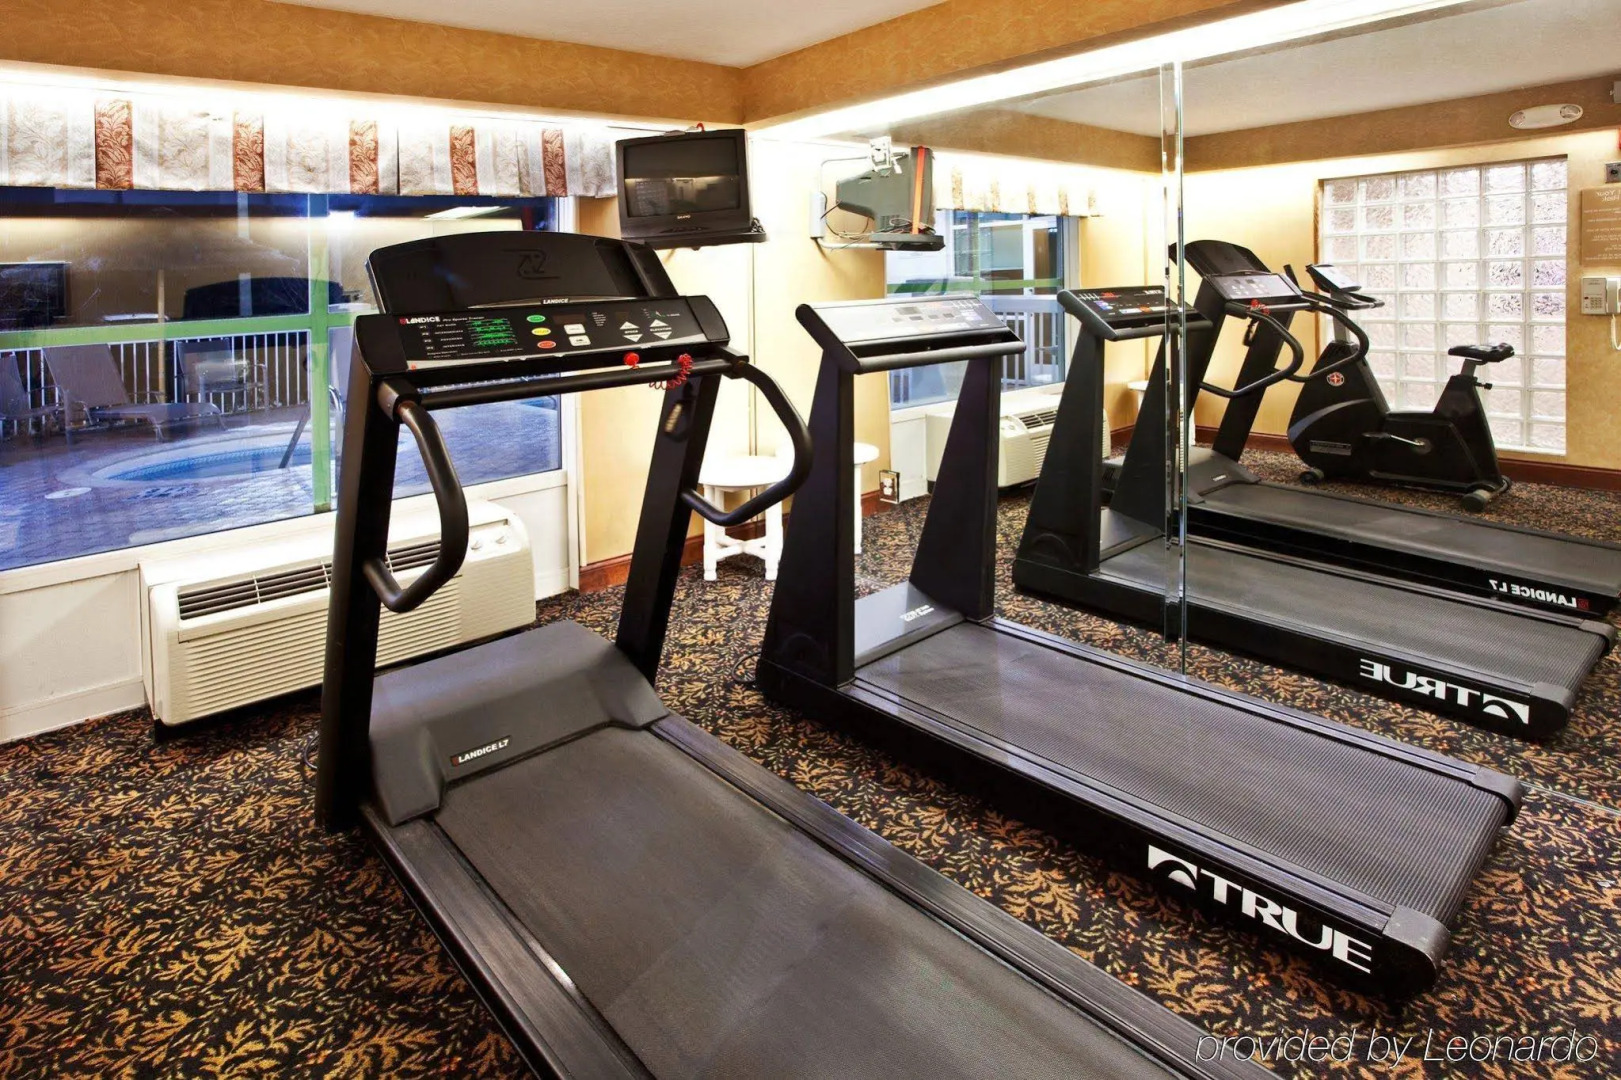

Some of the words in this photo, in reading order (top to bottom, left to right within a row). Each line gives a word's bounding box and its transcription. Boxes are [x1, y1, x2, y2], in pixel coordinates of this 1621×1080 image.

[405, 316, 441, 324] LANDICE
[458, 743, 498, 763] LANDICE
[498, 739, 509, 749] L7
[1200, 868, 1372, 974] TRUE
